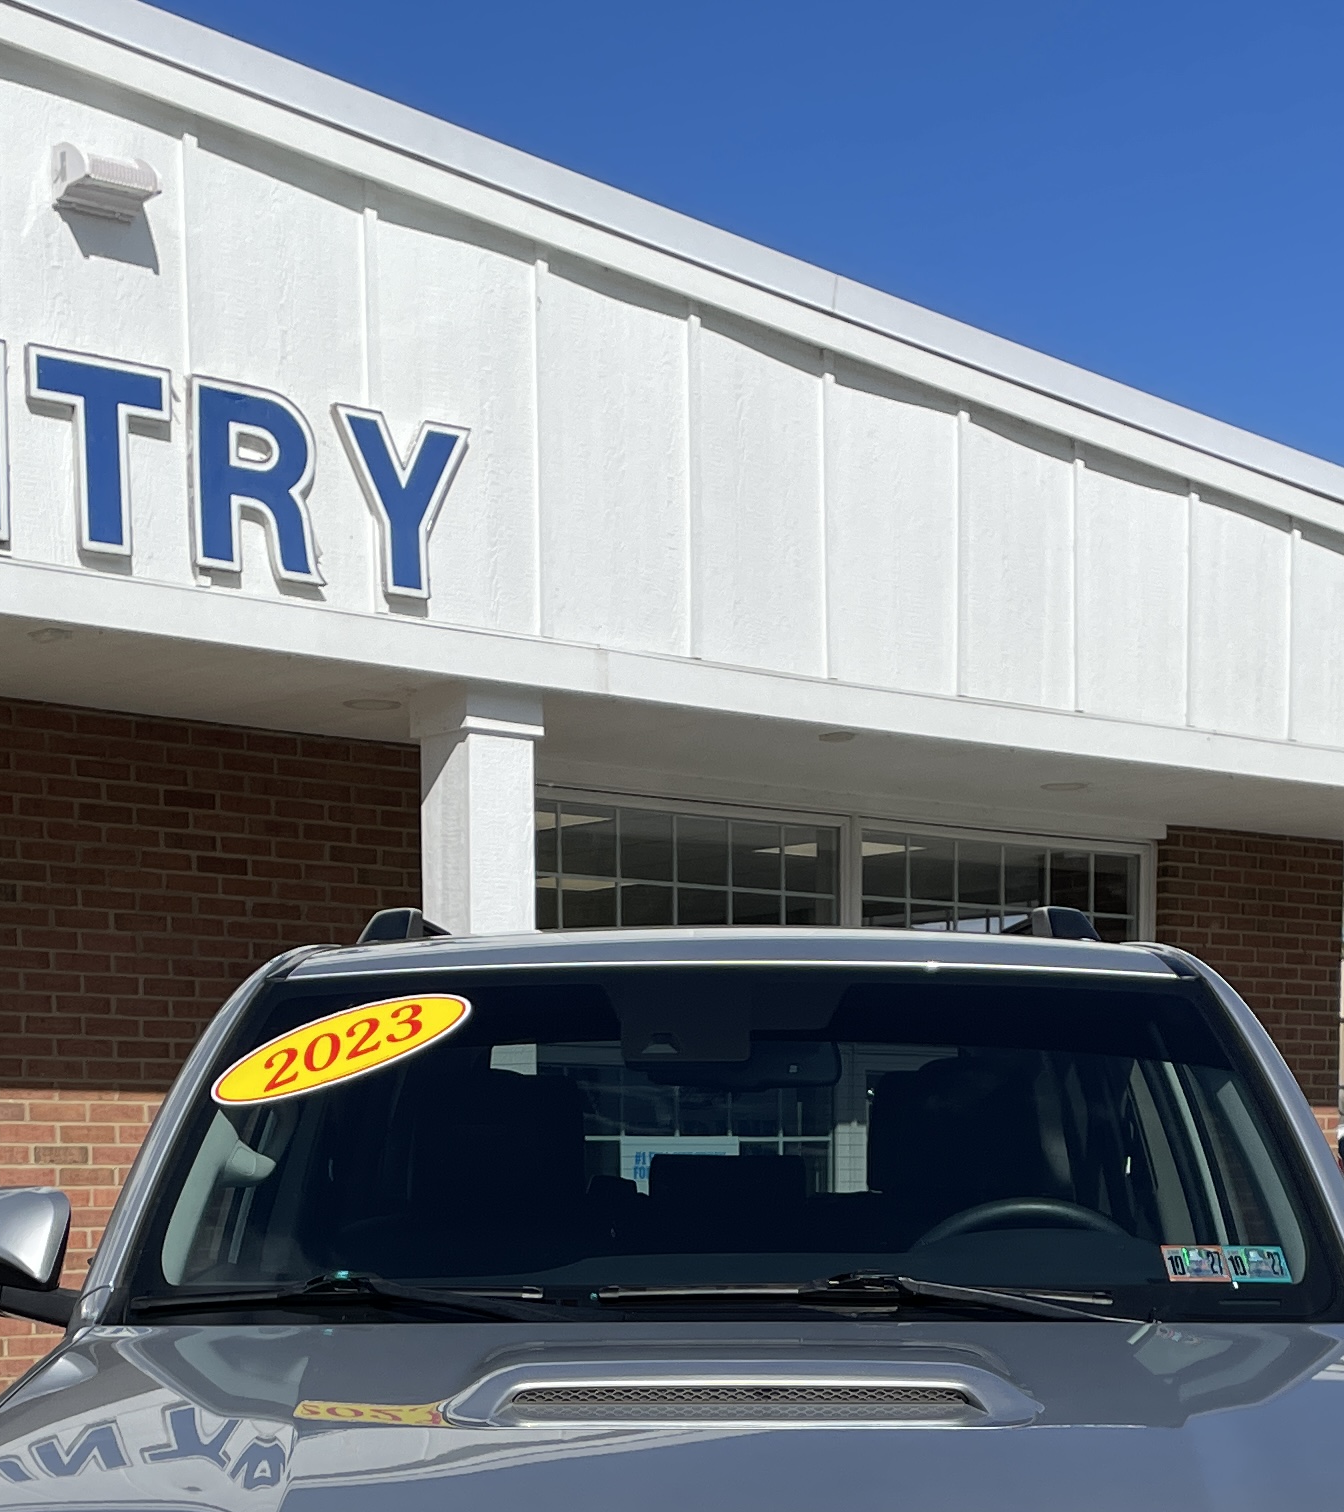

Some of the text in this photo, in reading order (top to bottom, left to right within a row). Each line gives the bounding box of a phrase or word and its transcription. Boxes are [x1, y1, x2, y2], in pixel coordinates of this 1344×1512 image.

[263, 1004, 423, 1093] 2023
[1167, 1255, 1186, 1275] 10
[1227, 1255, 1247, 1276] 10
